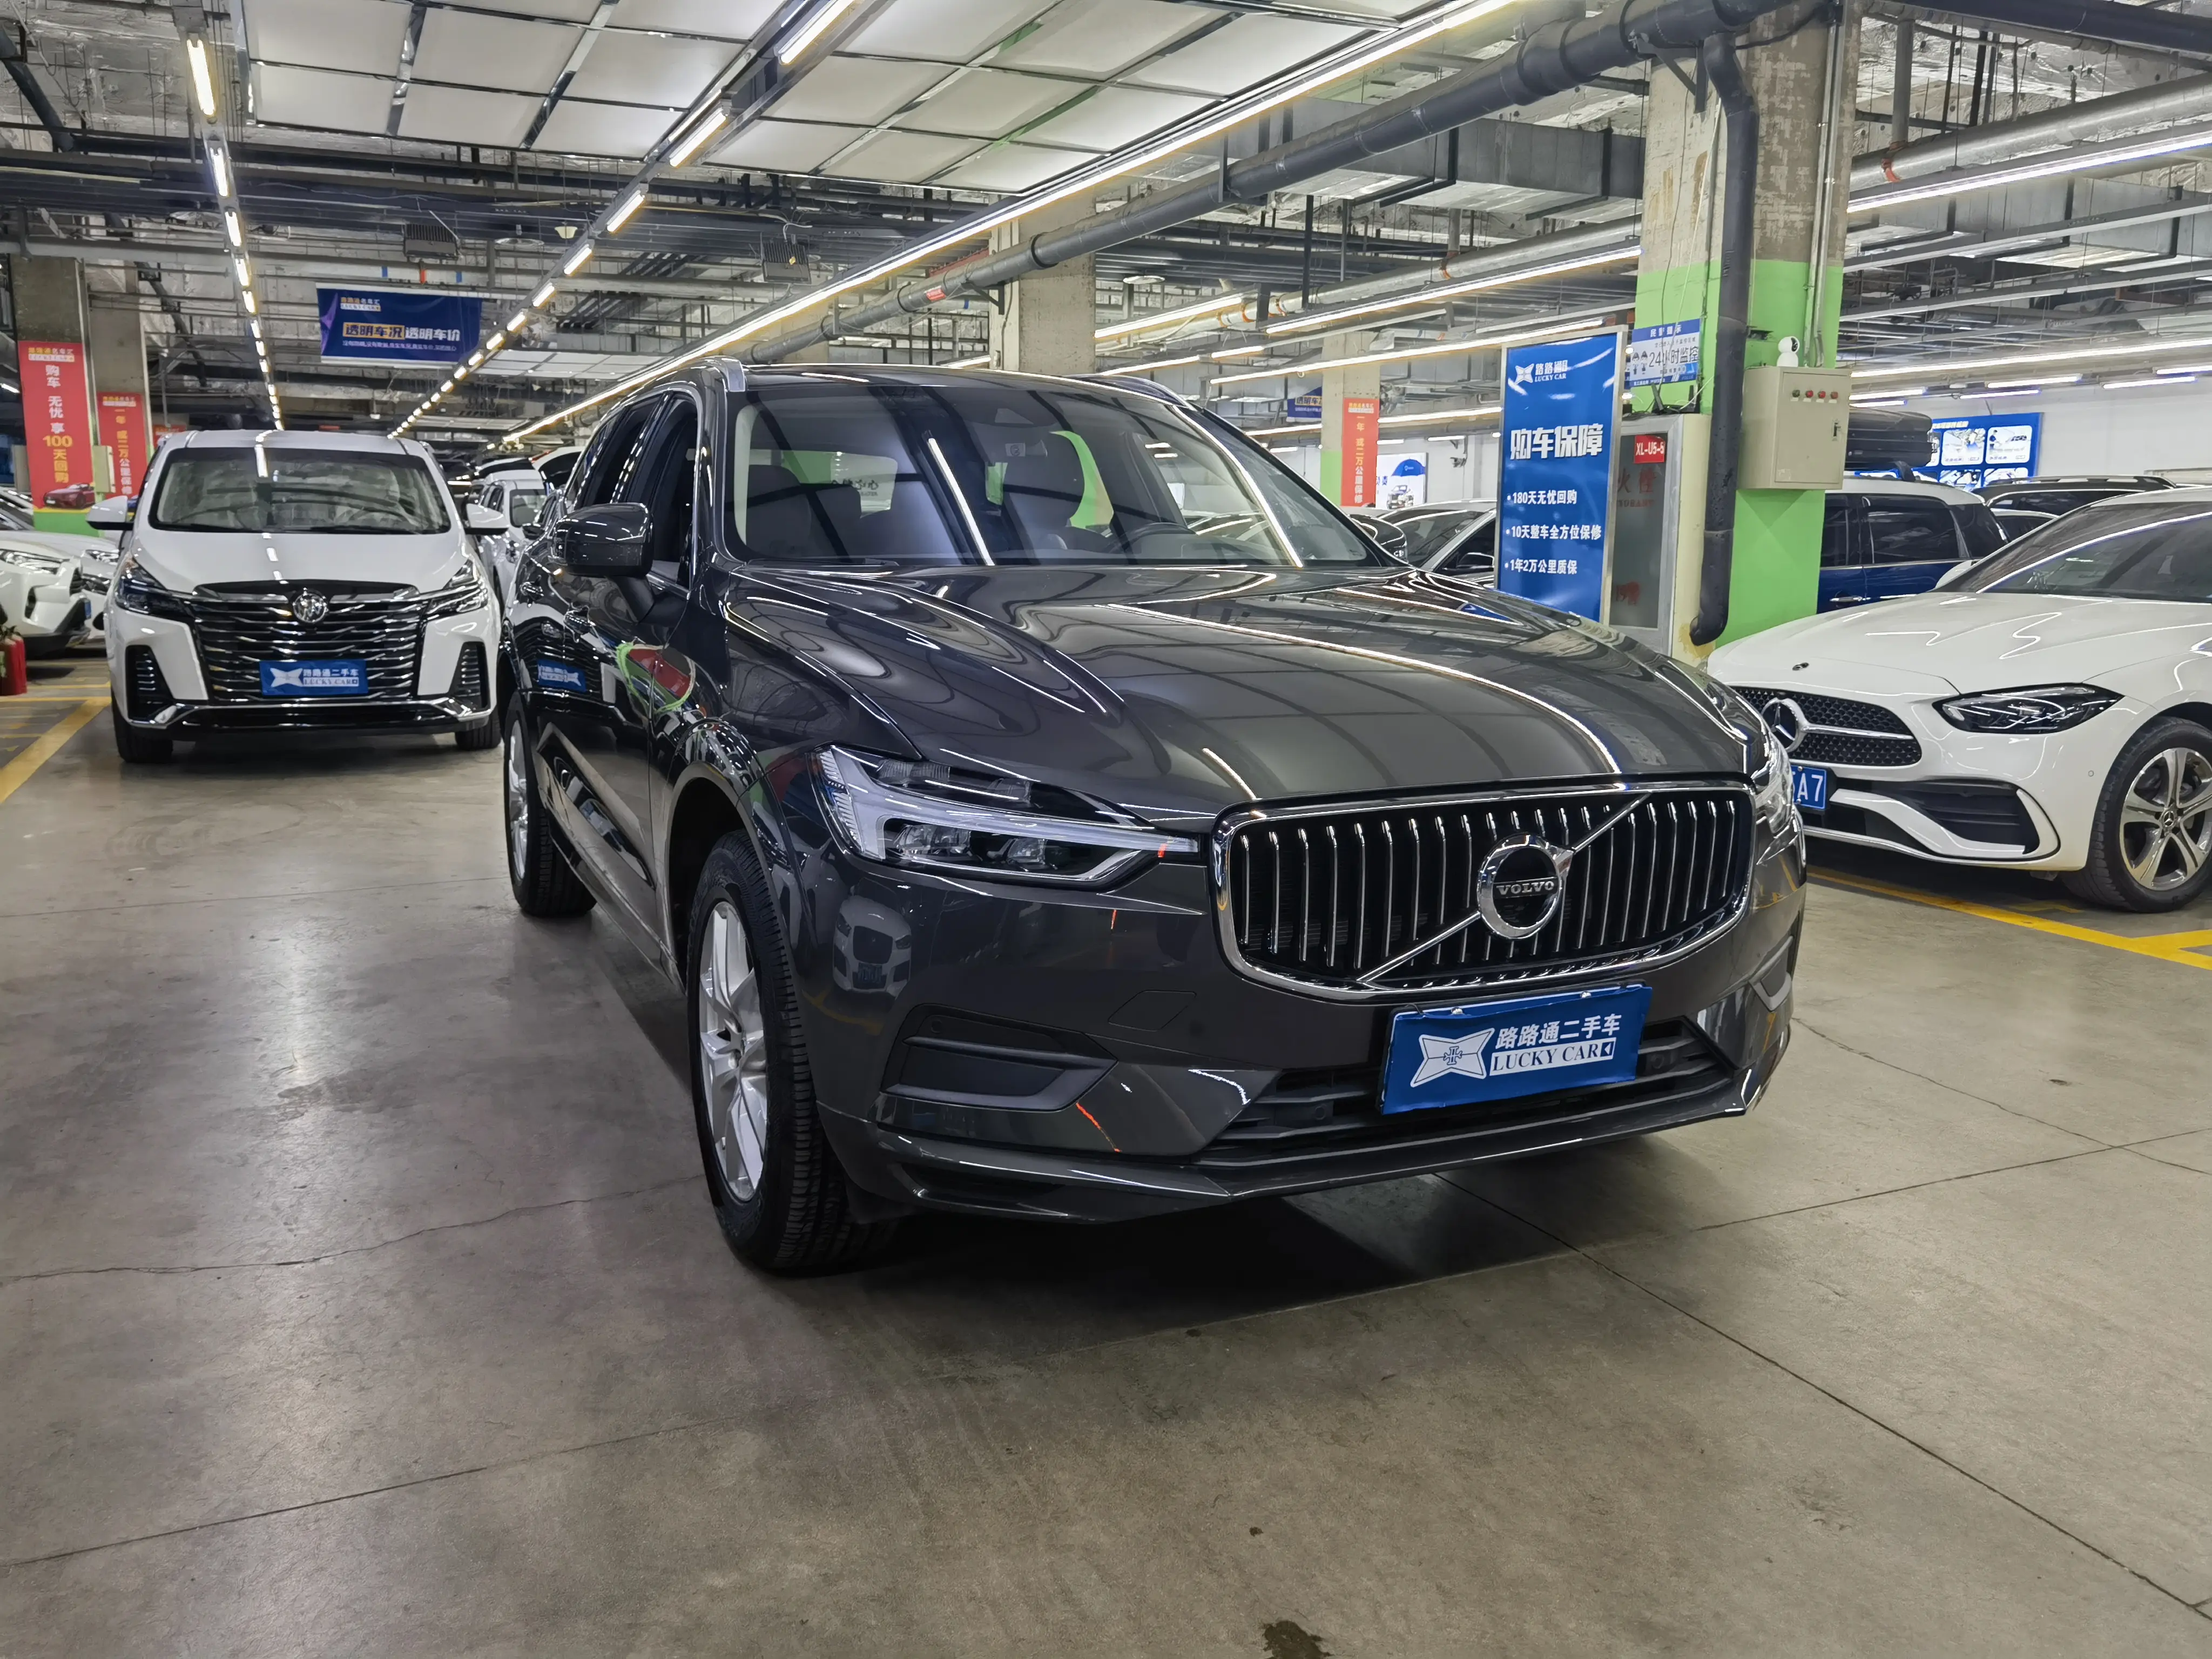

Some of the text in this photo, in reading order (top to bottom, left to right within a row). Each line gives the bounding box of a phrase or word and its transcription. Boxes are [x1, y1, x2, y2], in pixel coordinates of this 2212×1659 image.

[1535, 374, 1553, 382] LUCKY
[1510, 423, 1603, 460] 购车保障
[1513, 489, 1577, 504] 180天无忧回购
[1512, 524, 1601, 539] 10天整车全方位保修
[1510, 558, 1577, 574] 1年2万公里质保
[1793, 772, 1823, 801] A7
[1496, 881, 1554, 895] VOLVO
[1495, 1014, 1622, 1049] 路路通二手车
[1492, 1043, 1599, 1071] LUCKY CAR
